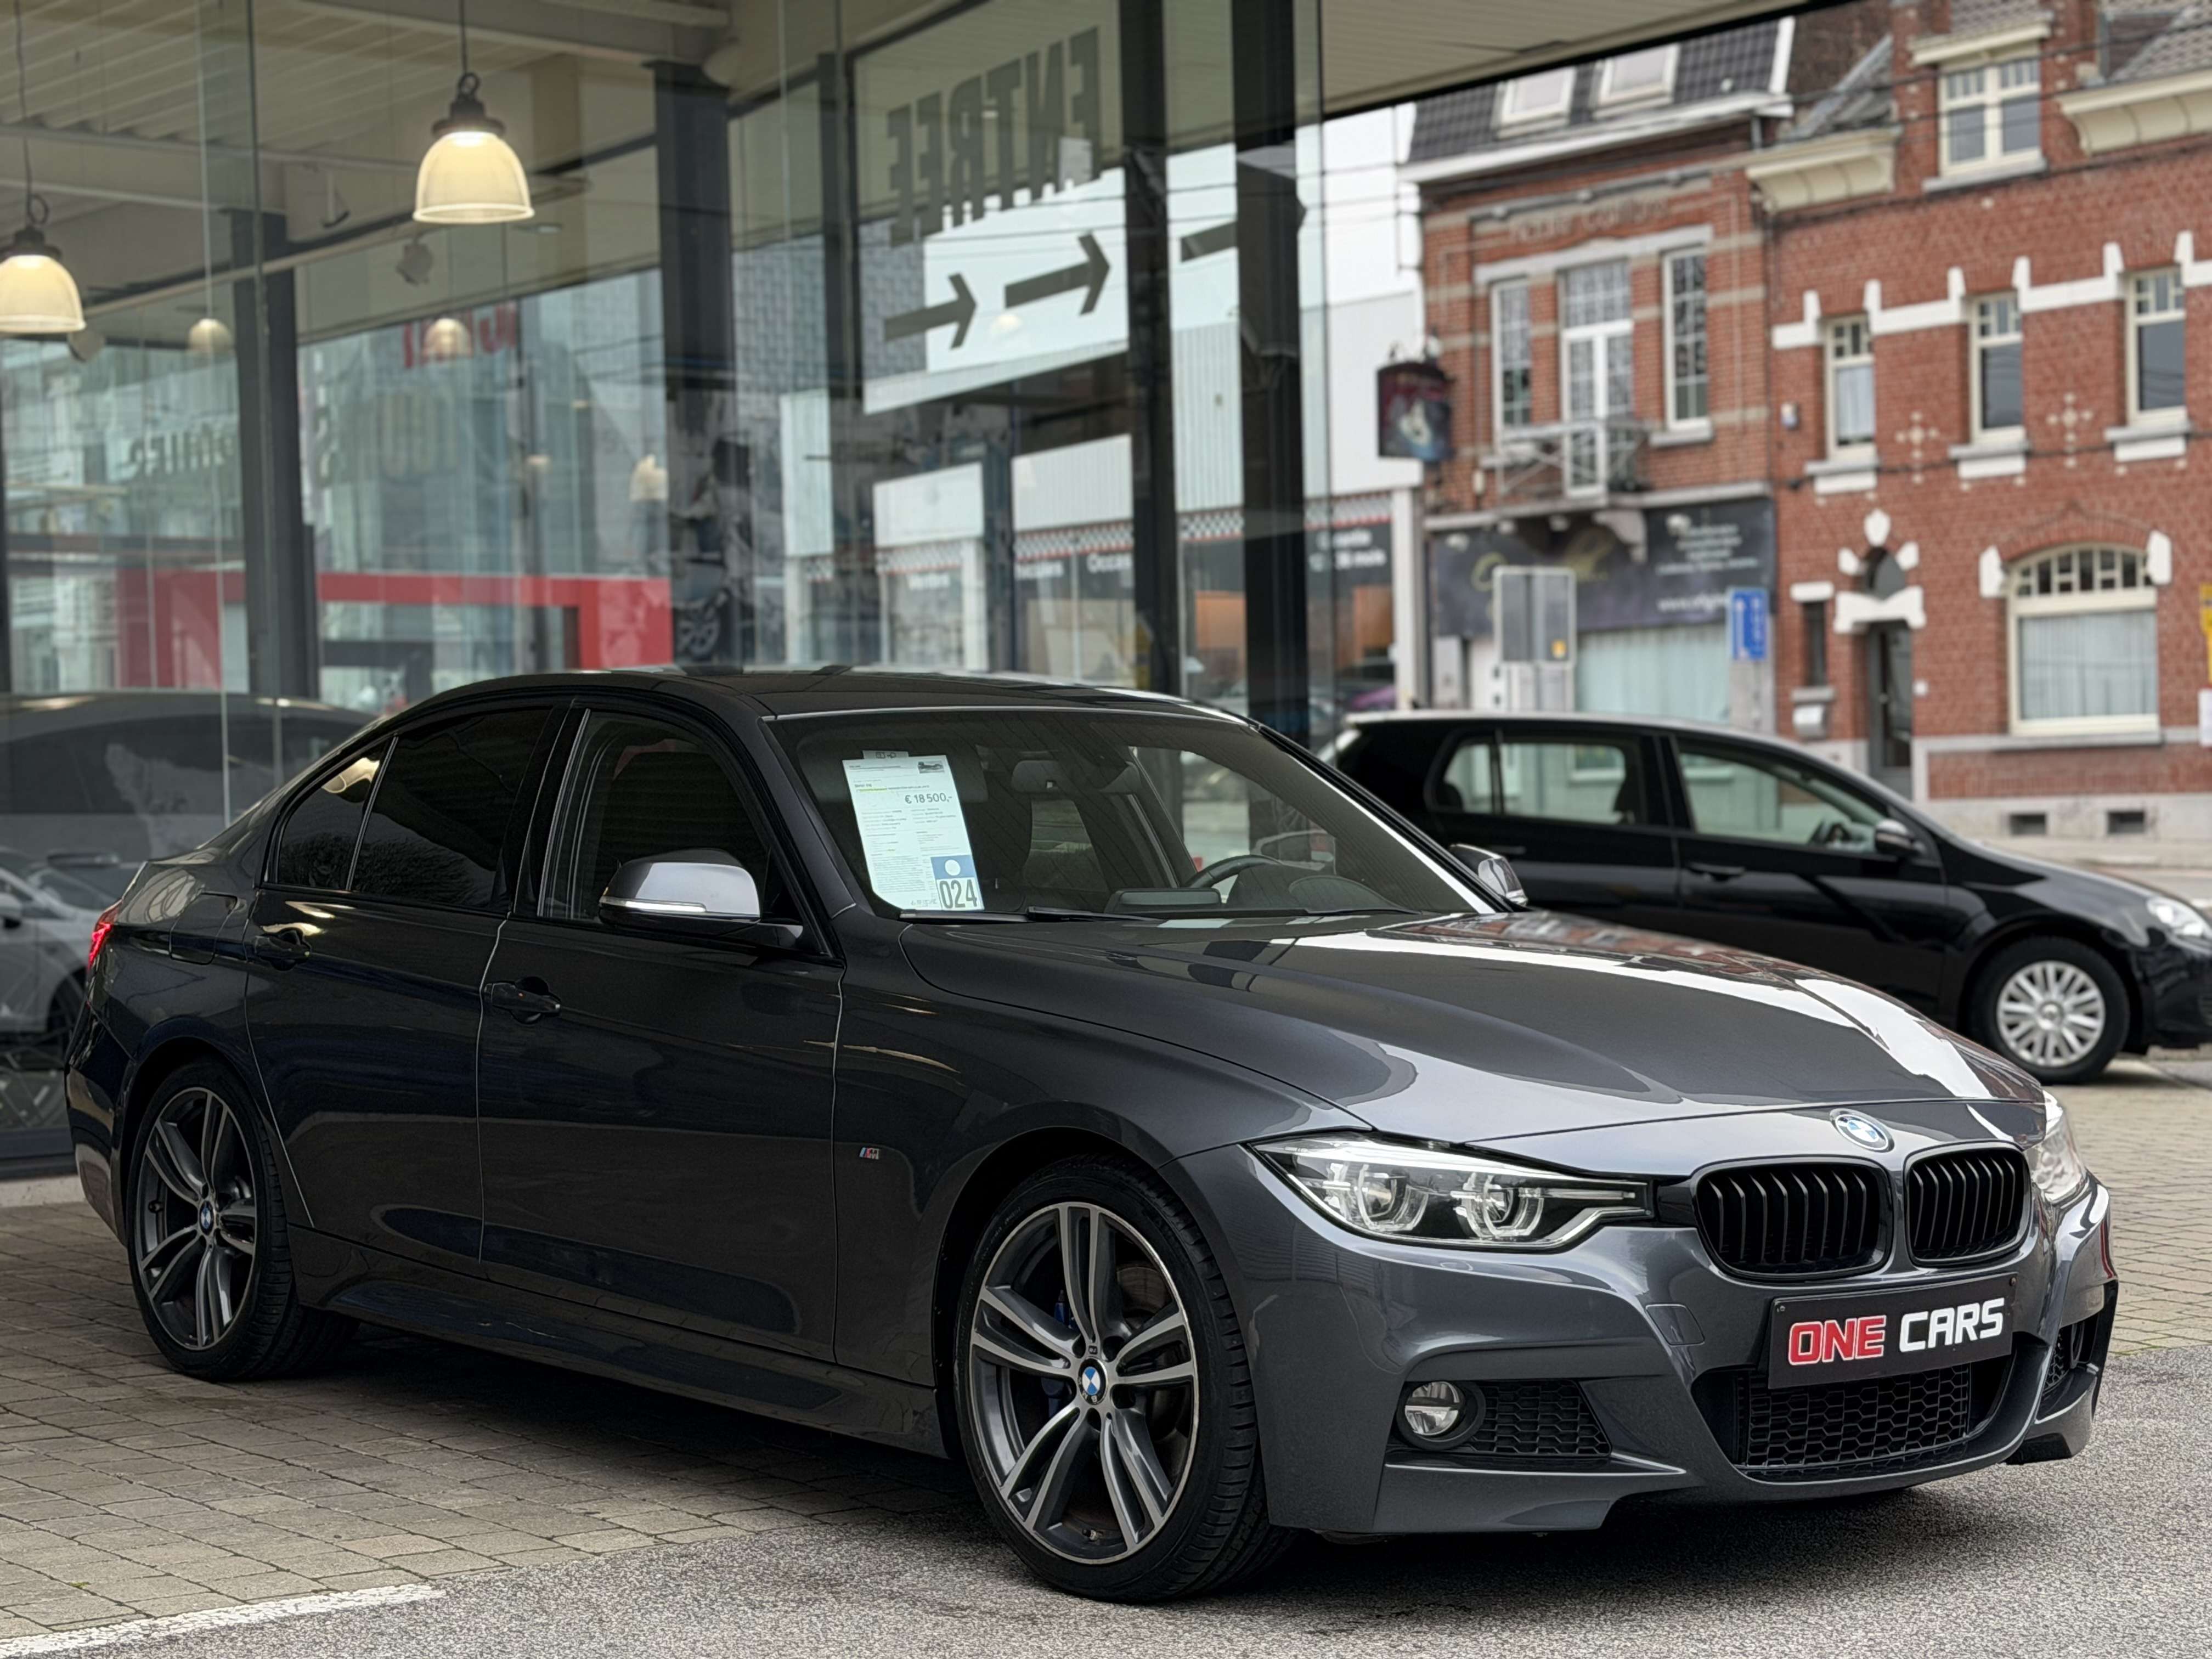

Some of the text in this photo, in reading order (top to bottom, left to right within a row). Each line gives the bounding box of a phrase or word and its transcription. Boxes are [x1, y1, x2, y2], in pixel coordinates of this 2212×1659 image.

[905, 794, 912, 804] €
[914, 794, 925, 803] 18
[939, 879, 977, 909] 024
[1788, 1297, 2005, 1365] ONE CARS
